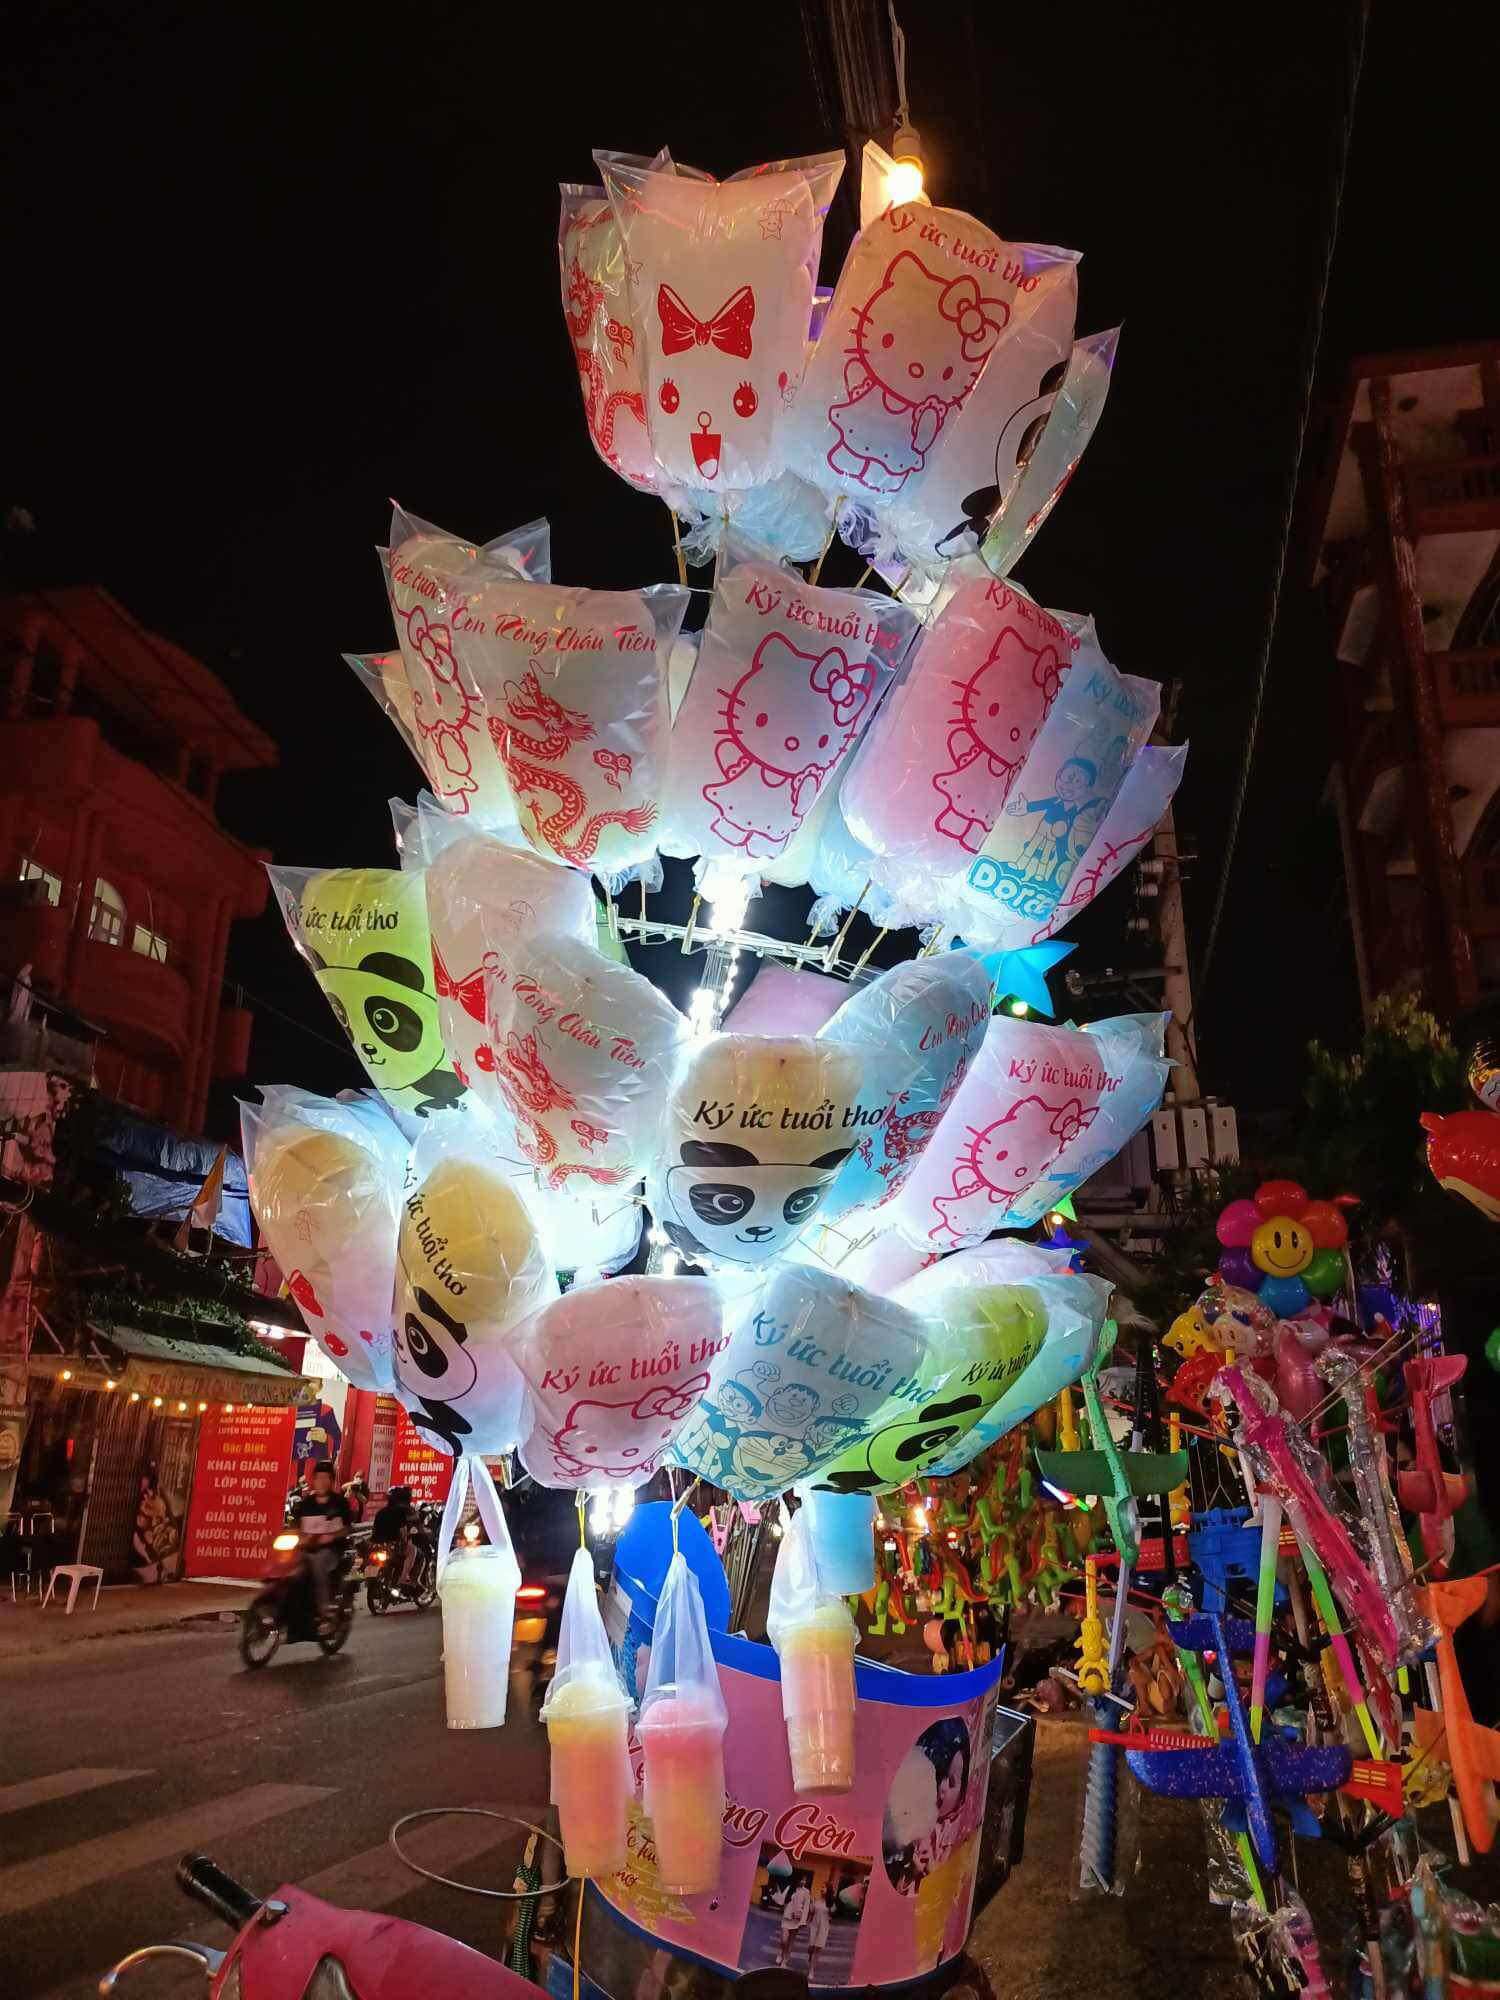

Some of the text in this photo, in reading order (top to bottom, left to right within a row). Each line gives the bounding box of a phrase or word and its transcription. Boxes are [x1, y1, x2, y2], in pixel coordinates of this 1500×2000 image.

[919, 222, 948, 249] ức
[951, 238, 1000, 273] tuổi
[1002, 260, 1041, 293] thơ
[745, 580, 782, 615] Ký
[785, 599, 815, 626] ức
[817, 610, 861, 640] tuổi
[985, 580, 1012, 610] Ký
[452, 606, 487, 634] Con
[555, 626, 604, 652] Cháu
[613, 625, 657, 651] Tiên
[305, 906, 328, 928] ức
[331, 903, 363, 930] tuổi
[366, 908, 399, 930] thơ
[1008, 1059, 1038, 1083] Ký
[1041, 1062, 1061, 1085] ức
[1063, 1064, 1094, 1090] tuổi
[693, 1098, 887, 1130] Ký ức tuổi thơ
[405, 1191, 426, 1221] ức
[415, 1217, 449, 1263] tuổi
[432, 1257, 468, 1296] thơ
[540, 1333, 732, 1394] Ký ức tuổi thơ
[752, 1310, 937, 1403] Ký ức tuổi thơ
[961, 1361, 991, 1386] Ký
[206, 1459, 236, 1472] KHAI
[399, 1462, 420, 1472] KHAI
[241, 1477, 267, 1490] HỌC
[774, 1802, 857, 1860] Gòn
